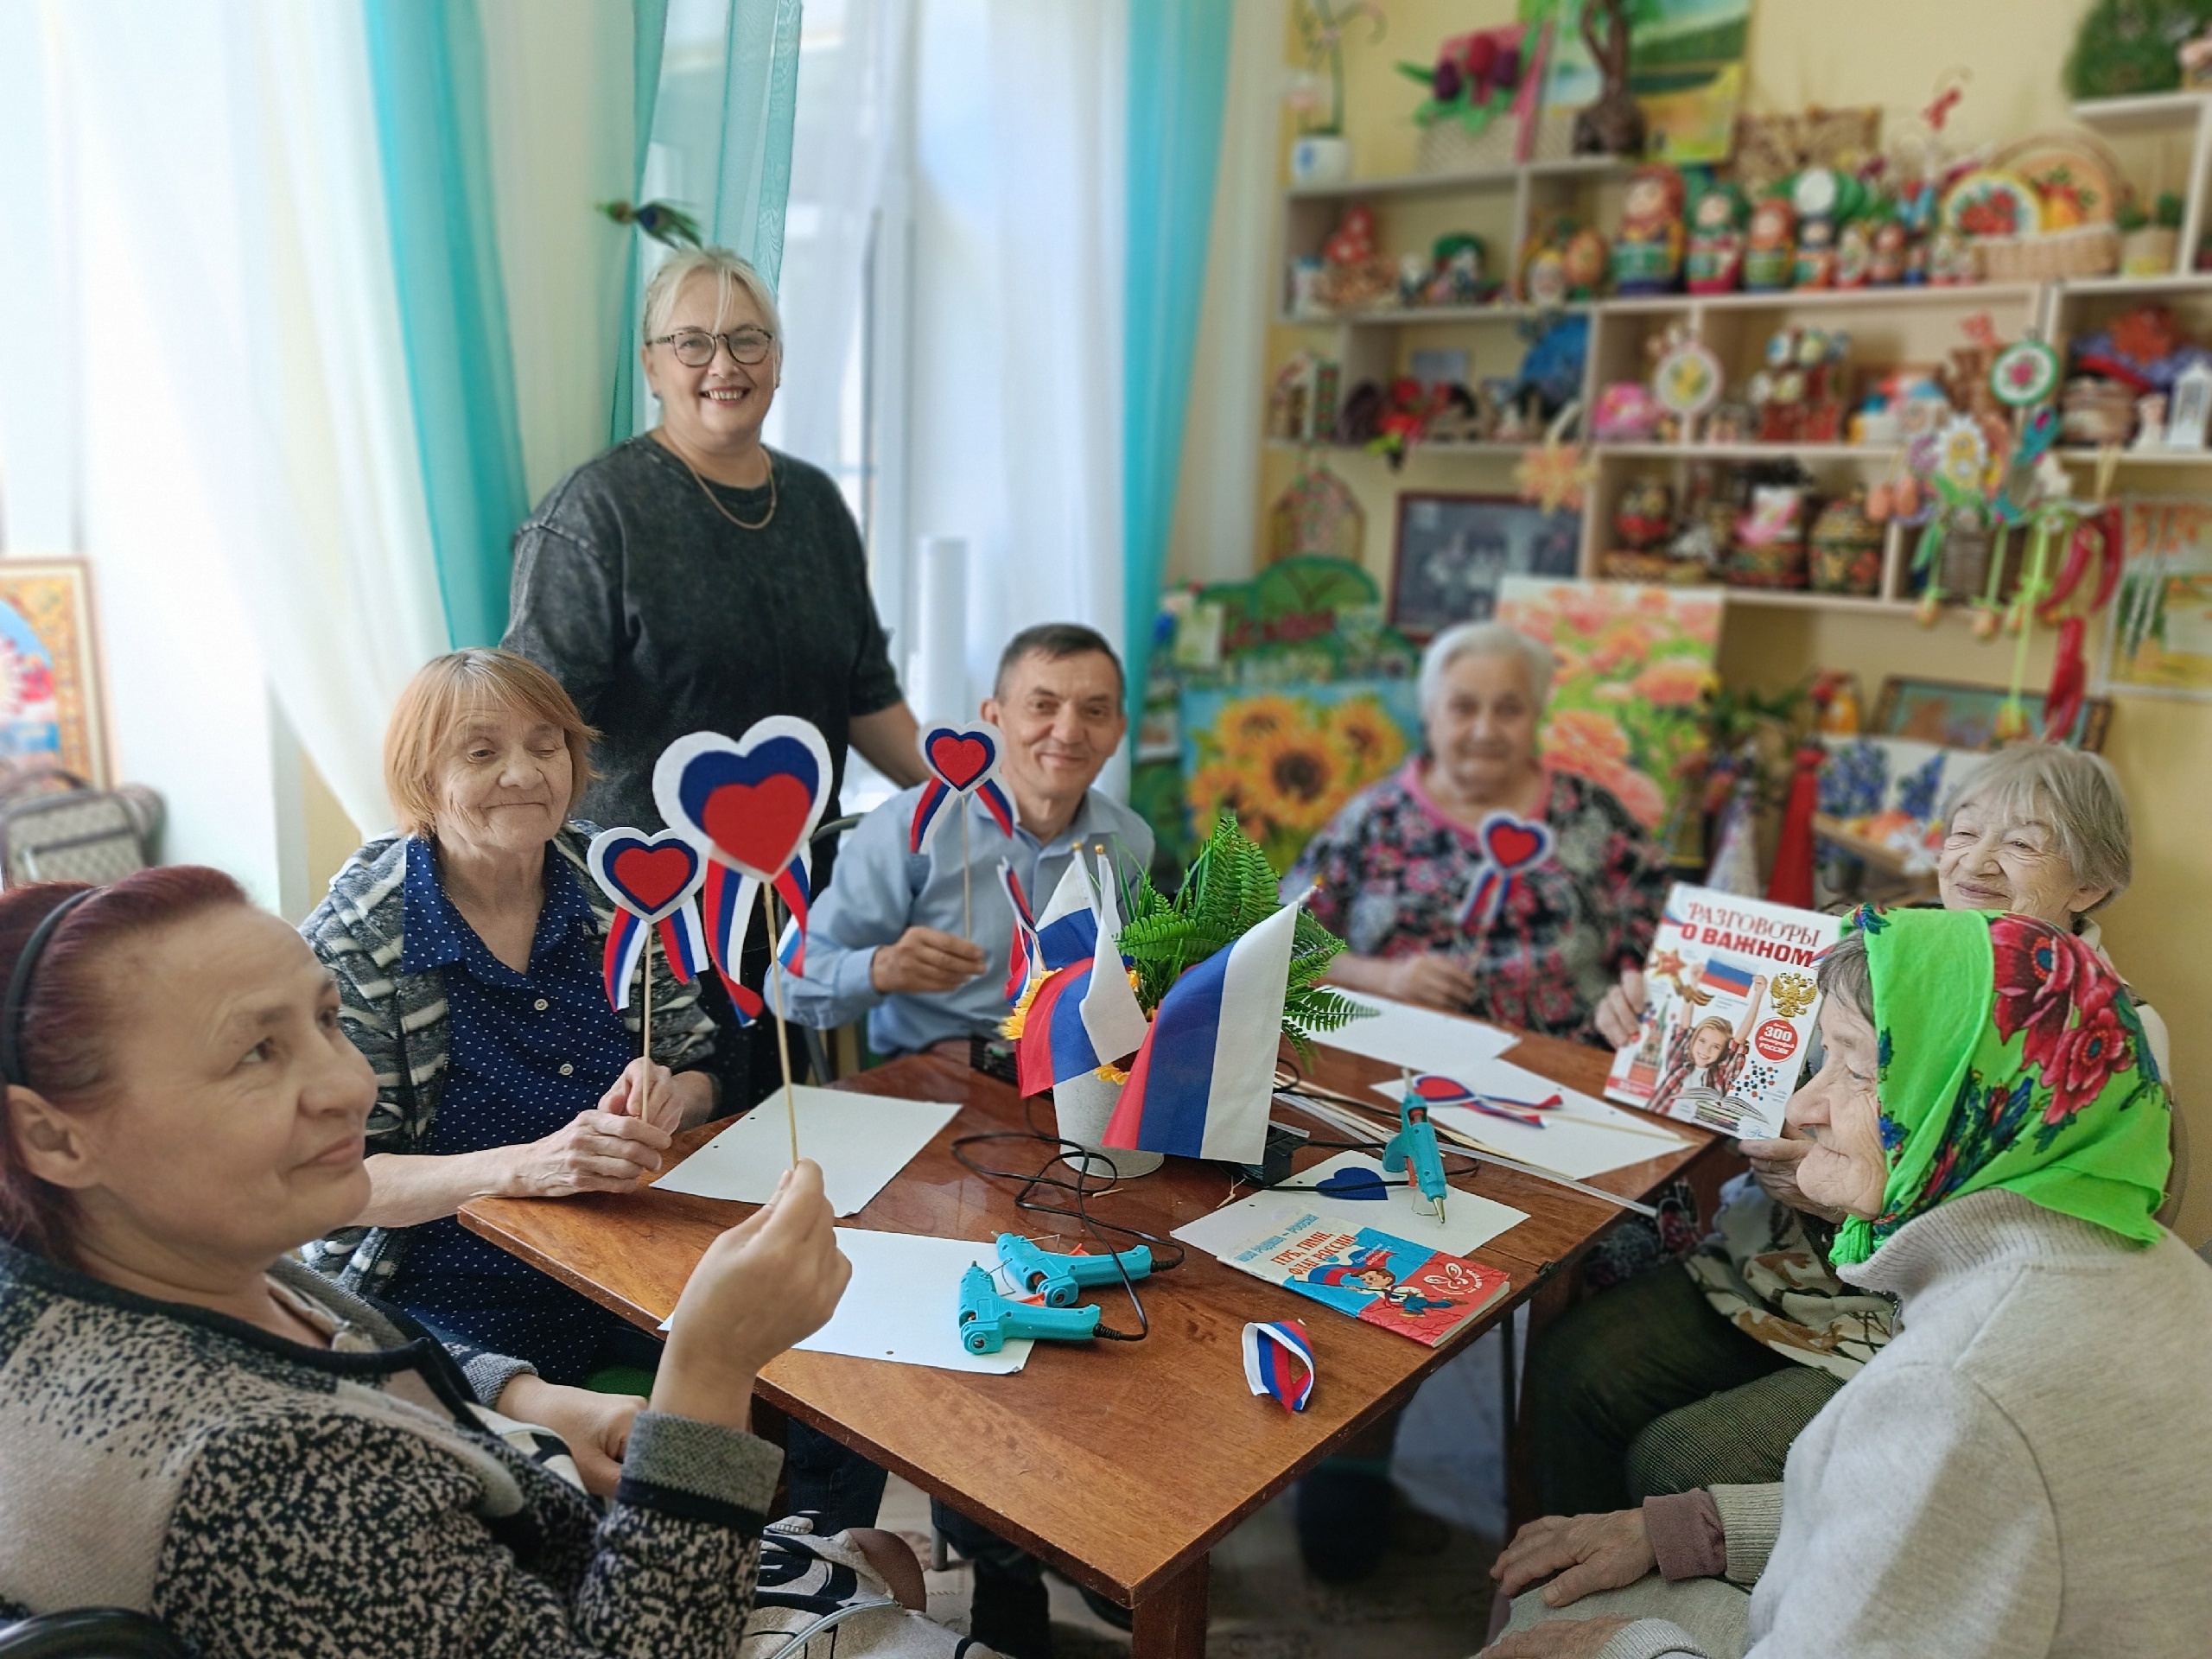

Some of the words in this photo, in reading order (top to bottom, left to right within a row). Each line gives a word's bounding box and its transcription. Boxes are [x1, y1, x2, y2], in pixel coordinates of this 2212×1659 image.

[1688, 901, 1821, 947] РАЗГОВОРЫ
[1681, 923, 1698, 940] О
[1700, 927, 1815, 968] ВАЖНОМ
[1764, 1026, 1793, 1042] 300
[1270, 1249, 1306, 1266] ГЕРБ,
[1296, 1230, 1336, 1251] ГИМН,
[1287, 1257, 1320, 1275] ФЛАГ
[1311, 1233, 1357, 1262] РОССИИ
